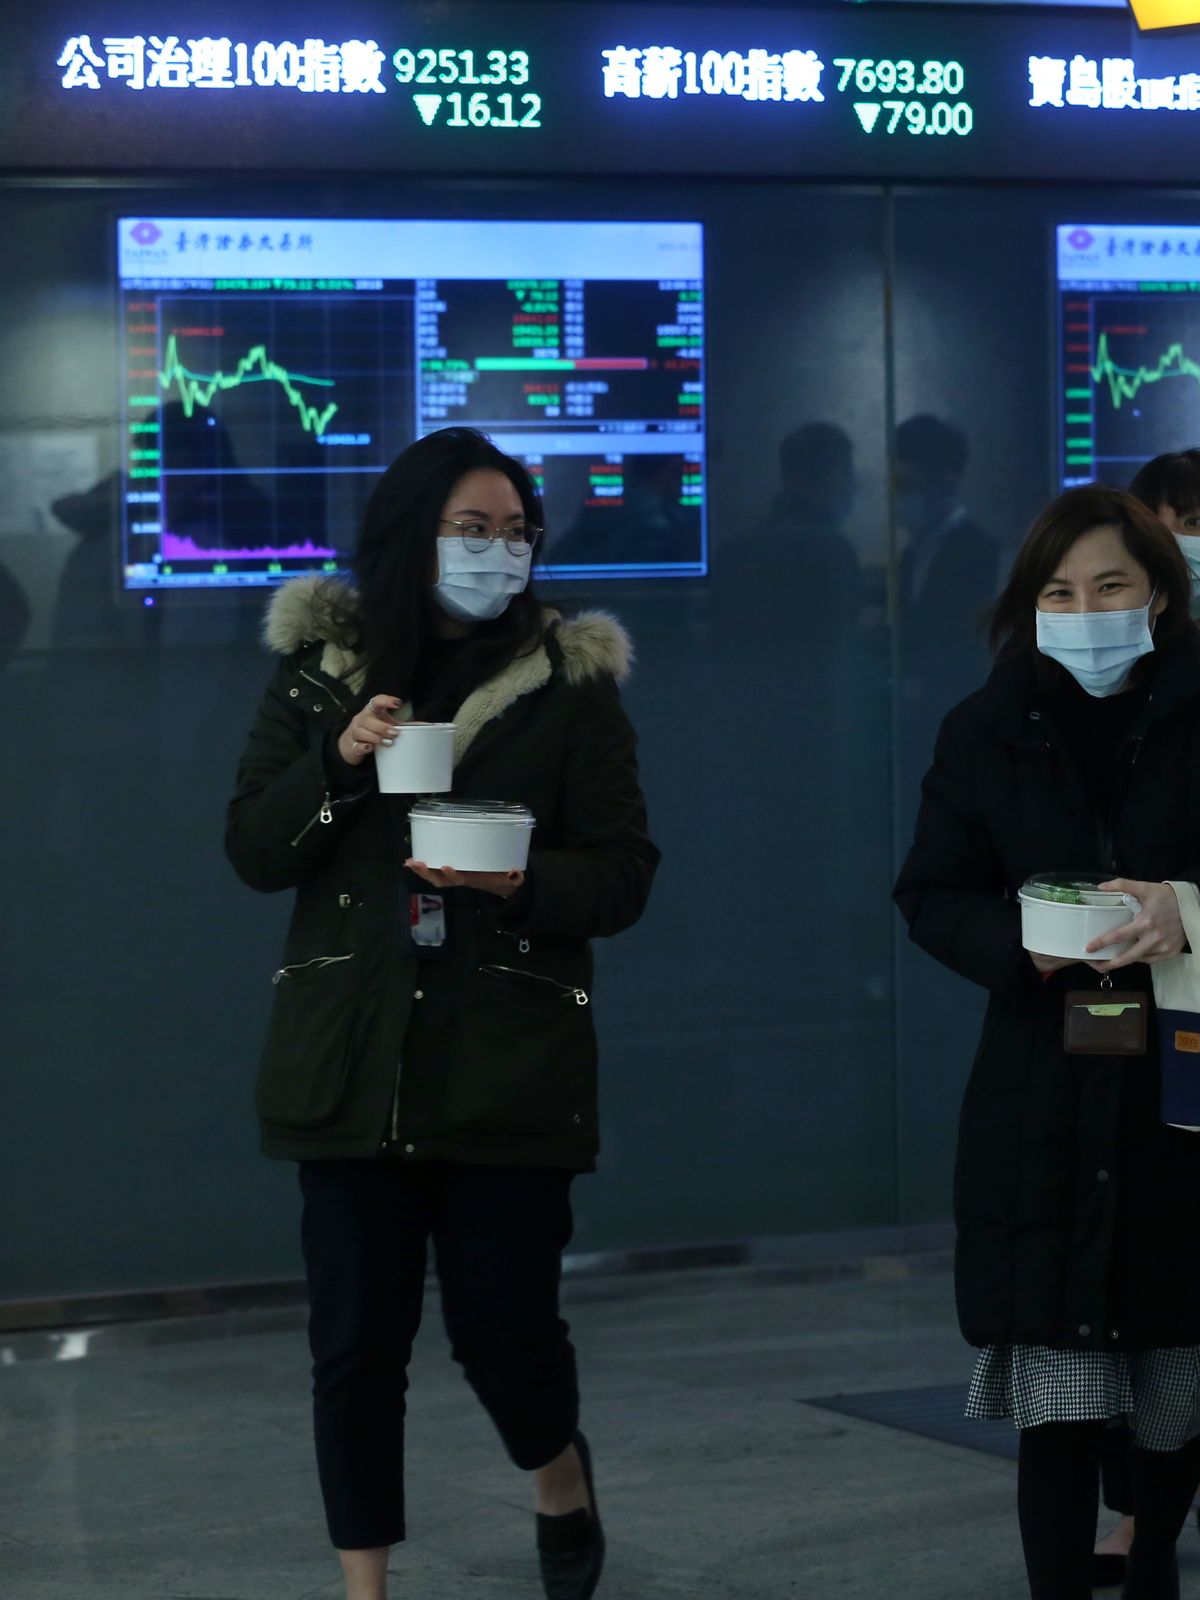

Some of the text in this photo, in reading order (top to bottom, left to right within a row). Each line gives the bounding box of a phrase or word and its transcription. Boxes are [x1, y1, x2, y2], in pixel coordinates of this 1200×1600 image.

[57, 35, 530, 93] 公司治理100指數 9251.33
[602, 46, 964, 102] 高薪100指數 7693.80
[446, 92, 542, 128] 16.12
[882, 102, 973, 135] 79.00
